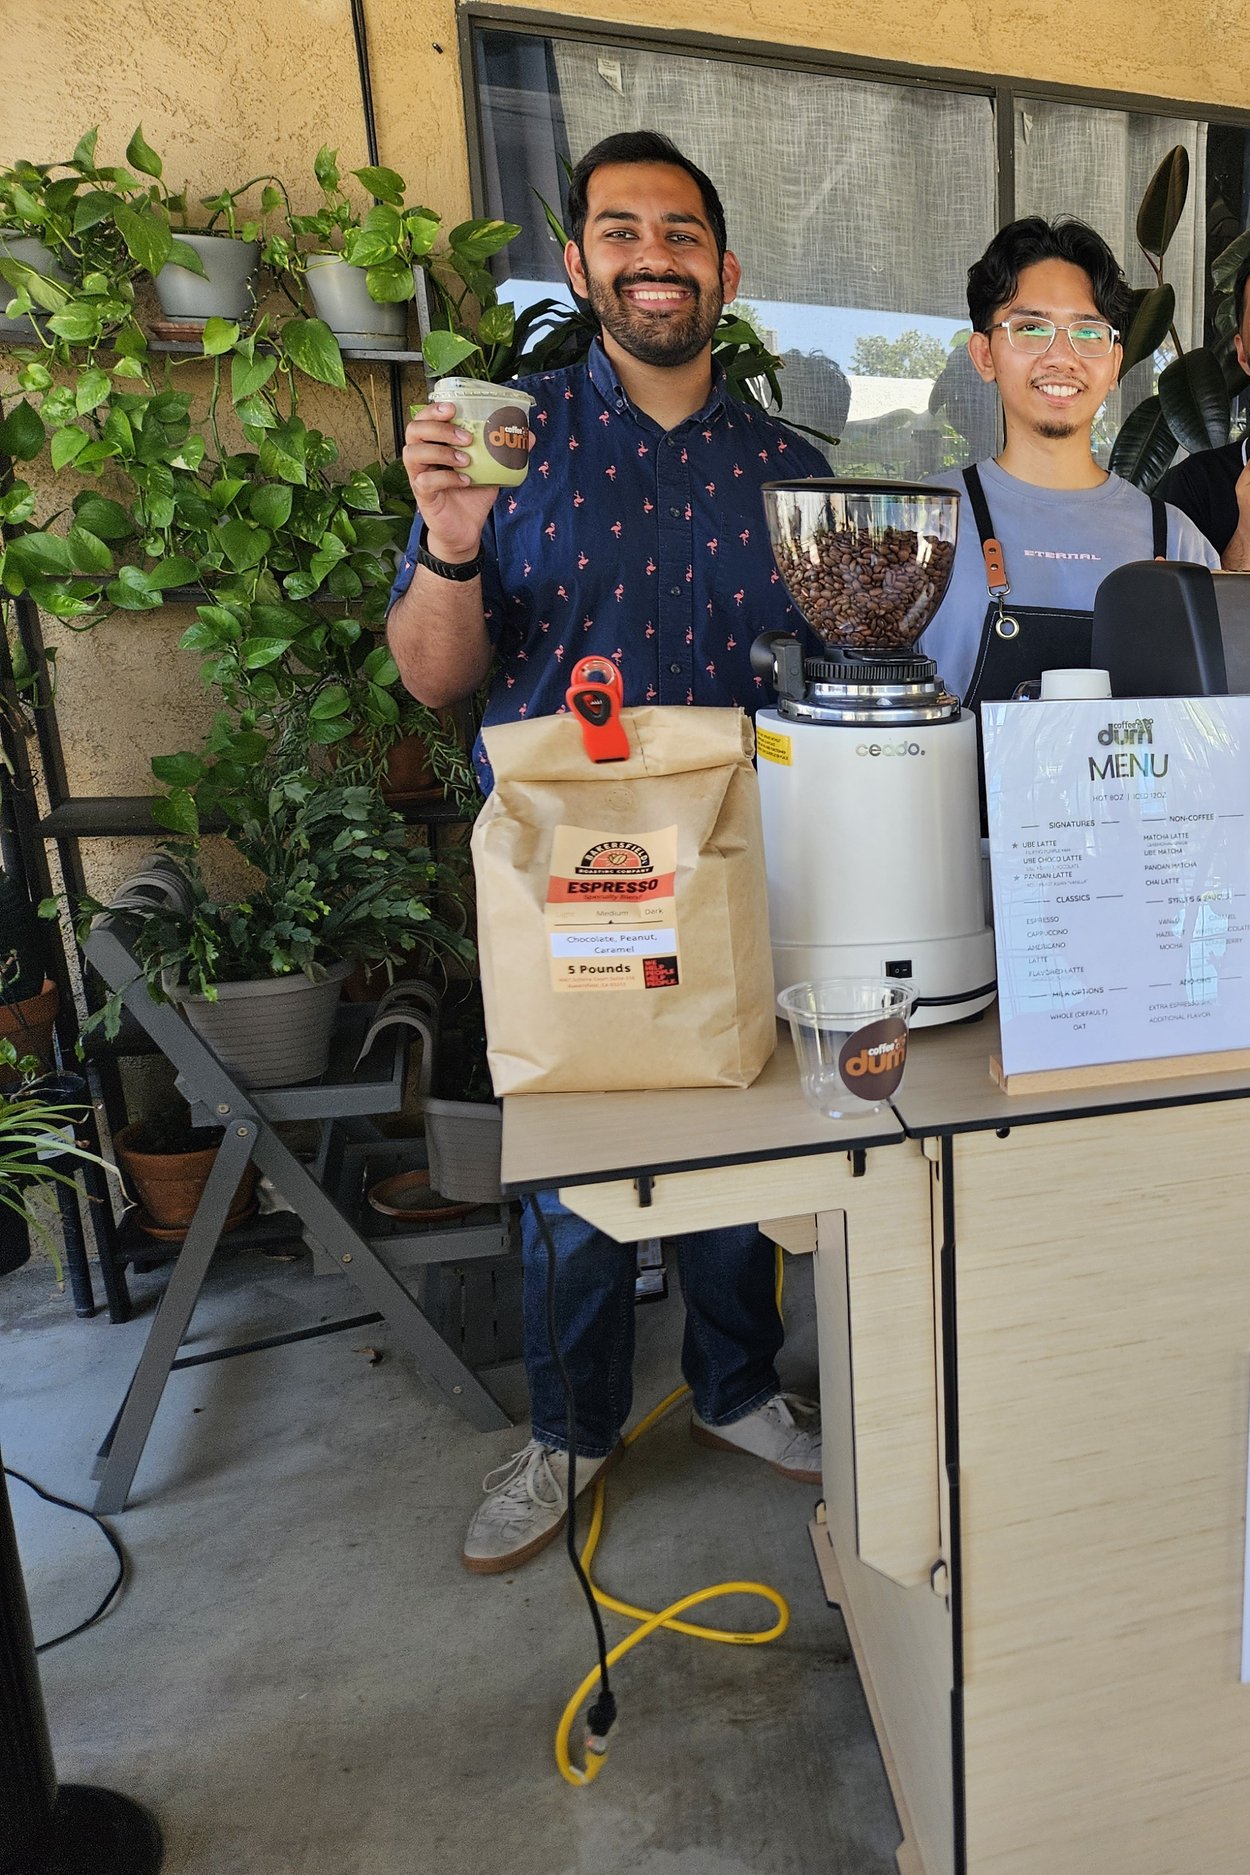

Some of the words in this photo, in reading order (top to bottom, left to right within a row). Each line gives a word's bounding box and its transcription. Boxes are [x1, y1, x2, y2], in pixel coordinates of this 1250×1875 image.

[1024, 549, 1102, 561] ETERNAL
[1113, 720, 1137, 729] coffee
[1088, 753, 1169, 782] MENU
[1169, 813, 1215, 822] NON-COFFEE
[1049, 819, 1096, 829] SIGNATURES
[1143, 833, 1169, 841] MATCHA
[584, 842, 650, 864] BAKERSFIELD
[1063, 854, 1082, 862] LATTE
[1144, 863, 1170, 871] PANDAN
[1024, 872, 1051, 880] PANDAN
[1161, 877, 1180, 885] LATTE
[567, 879, 659, 894] ESPRESSO
[1056, 894, 1091, 903] CLASSICS
[645, 908, 663, 916] Dark
[1026, 916, 1059, 925] ESPRESSO
[1156, 929, 1185, 938] HAZELT
[566, 935, 617, 944] Chocolate,
[620, 934, 658, 942] Peanut,
[594, 946, 635, 954] Caramel
[1027, 942, 1066, 951] AMERICANO
[1028, 956, 1048, 964] LATTE
[568, 965, 576, 974] 5
[579, 963, 632, 974] Pounds
[1028, 968, 1064, 977] FLAVORED
[1050, 1011, 1073, 1020] WHOLE
[1075, 1009, 1108, 1018] (DEFAULT)
[1149, 1015, 1185, 1023] ADDITIONAL
[867, 1042, 895, 1056] coffee
